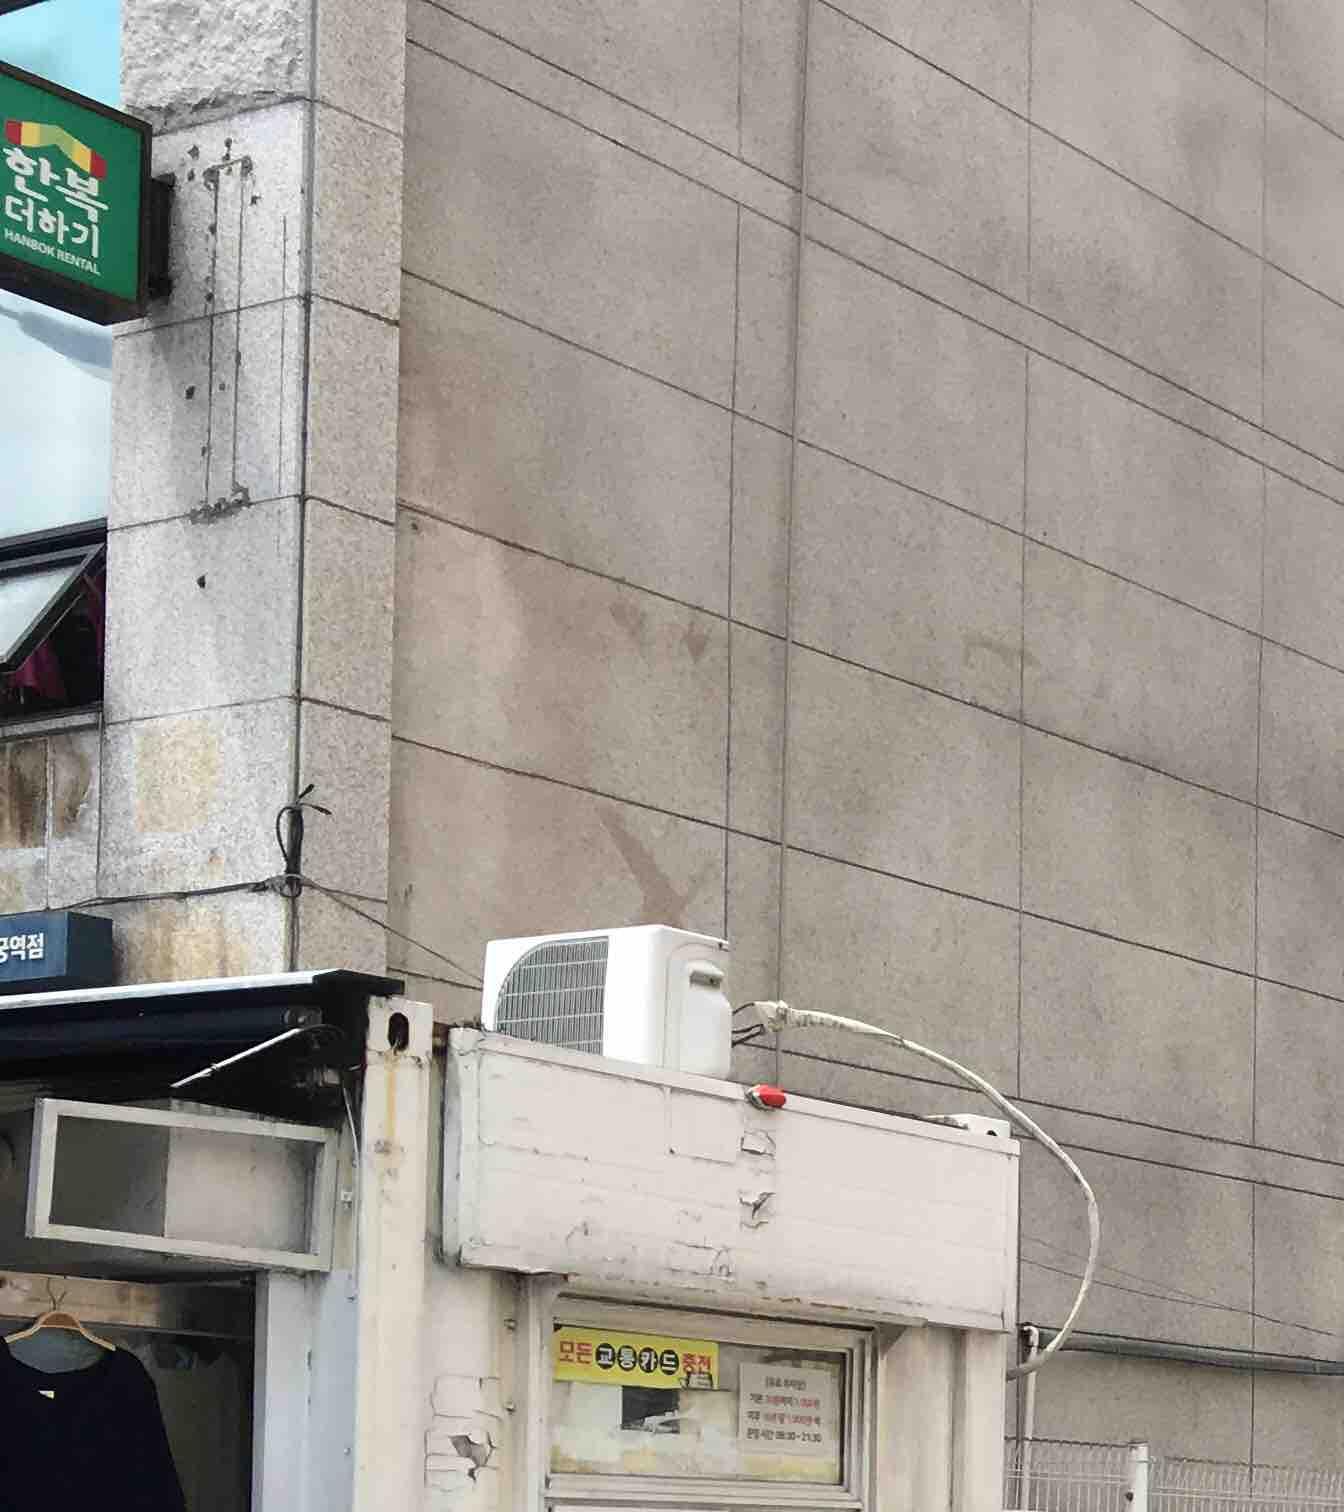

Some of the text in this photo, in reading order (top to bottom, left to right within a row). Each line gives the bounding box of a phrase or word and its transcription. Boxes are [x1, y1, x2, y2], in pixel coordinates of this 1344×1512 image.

[3, 147, 109, 223] 한복
[4, 229, 101, 276] HANBOK RENTAL
[5, 195, 100, 258] 더하기
[560, 1340, 593, 1365] 모든
[597, 1344, 678, 1374] 교통카드
